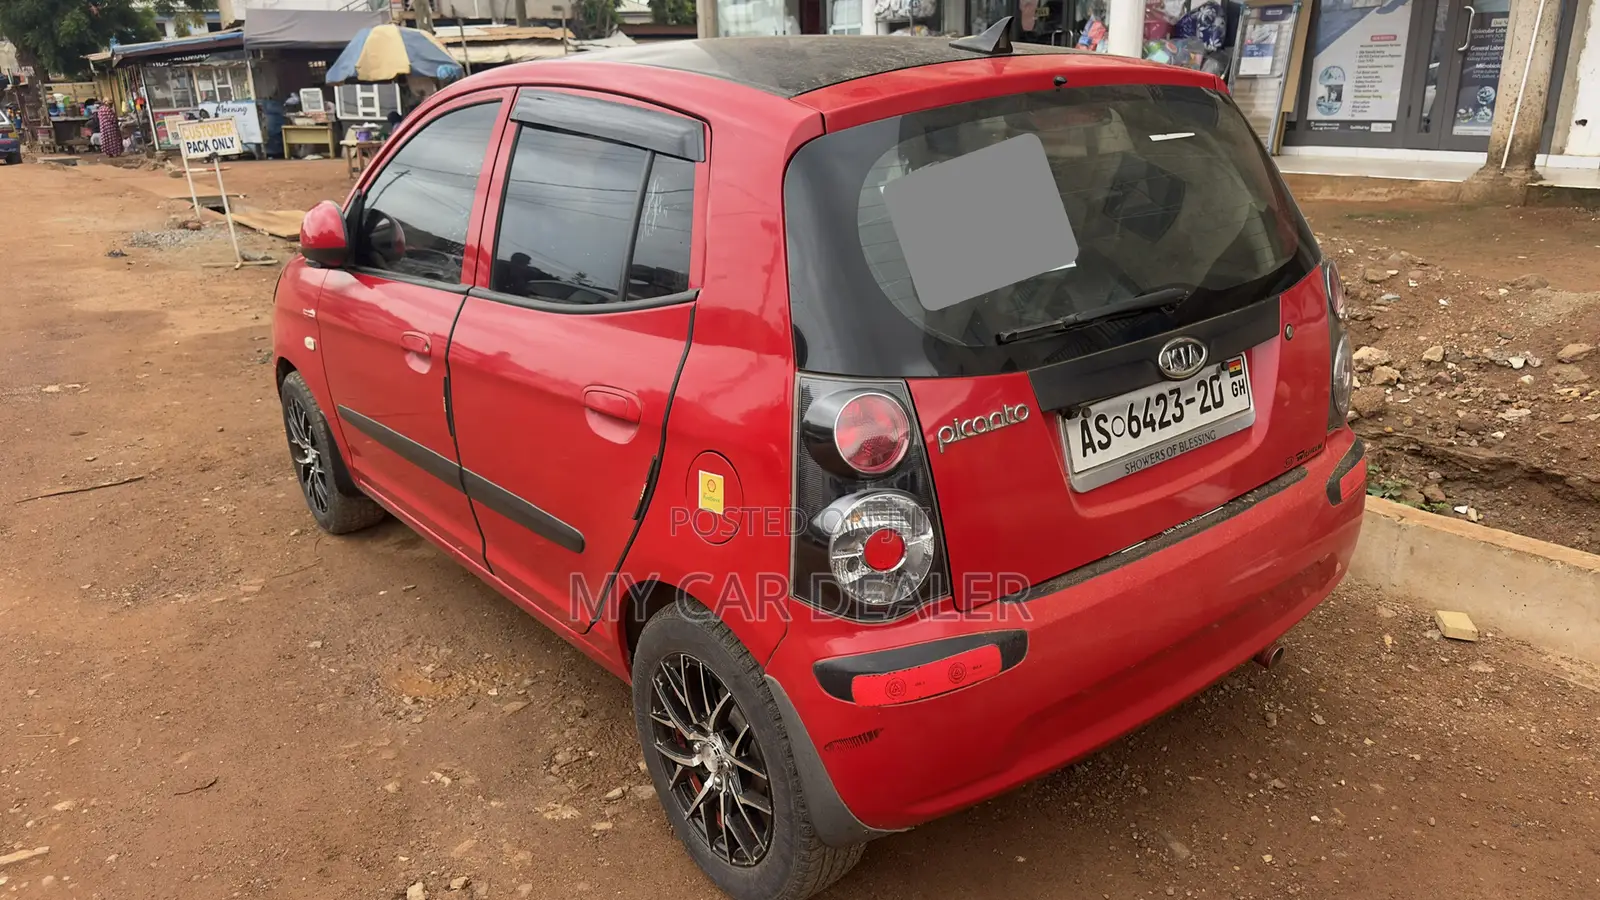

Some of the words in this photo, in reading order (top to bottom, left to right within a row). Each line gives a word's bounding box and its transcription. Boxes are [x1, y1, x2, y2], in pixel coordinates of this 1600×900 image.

[215, 104, 248, 115] Morning
[182, 121, 233, 139] CUSTOMER
[186, 139, 211, 154] PACK
[212, 136, 235, 151] ONLY
[1165, 343, 1201, 372] KIA
[1231, 378, 1246, 397] GH
[937, 403, 1029, 454] picanto
[1125, 453, 1166, 475] SHOWERS
[1166, 443, 1178, 460] OF
[1178, 429, 1217, 452] BLESSING
